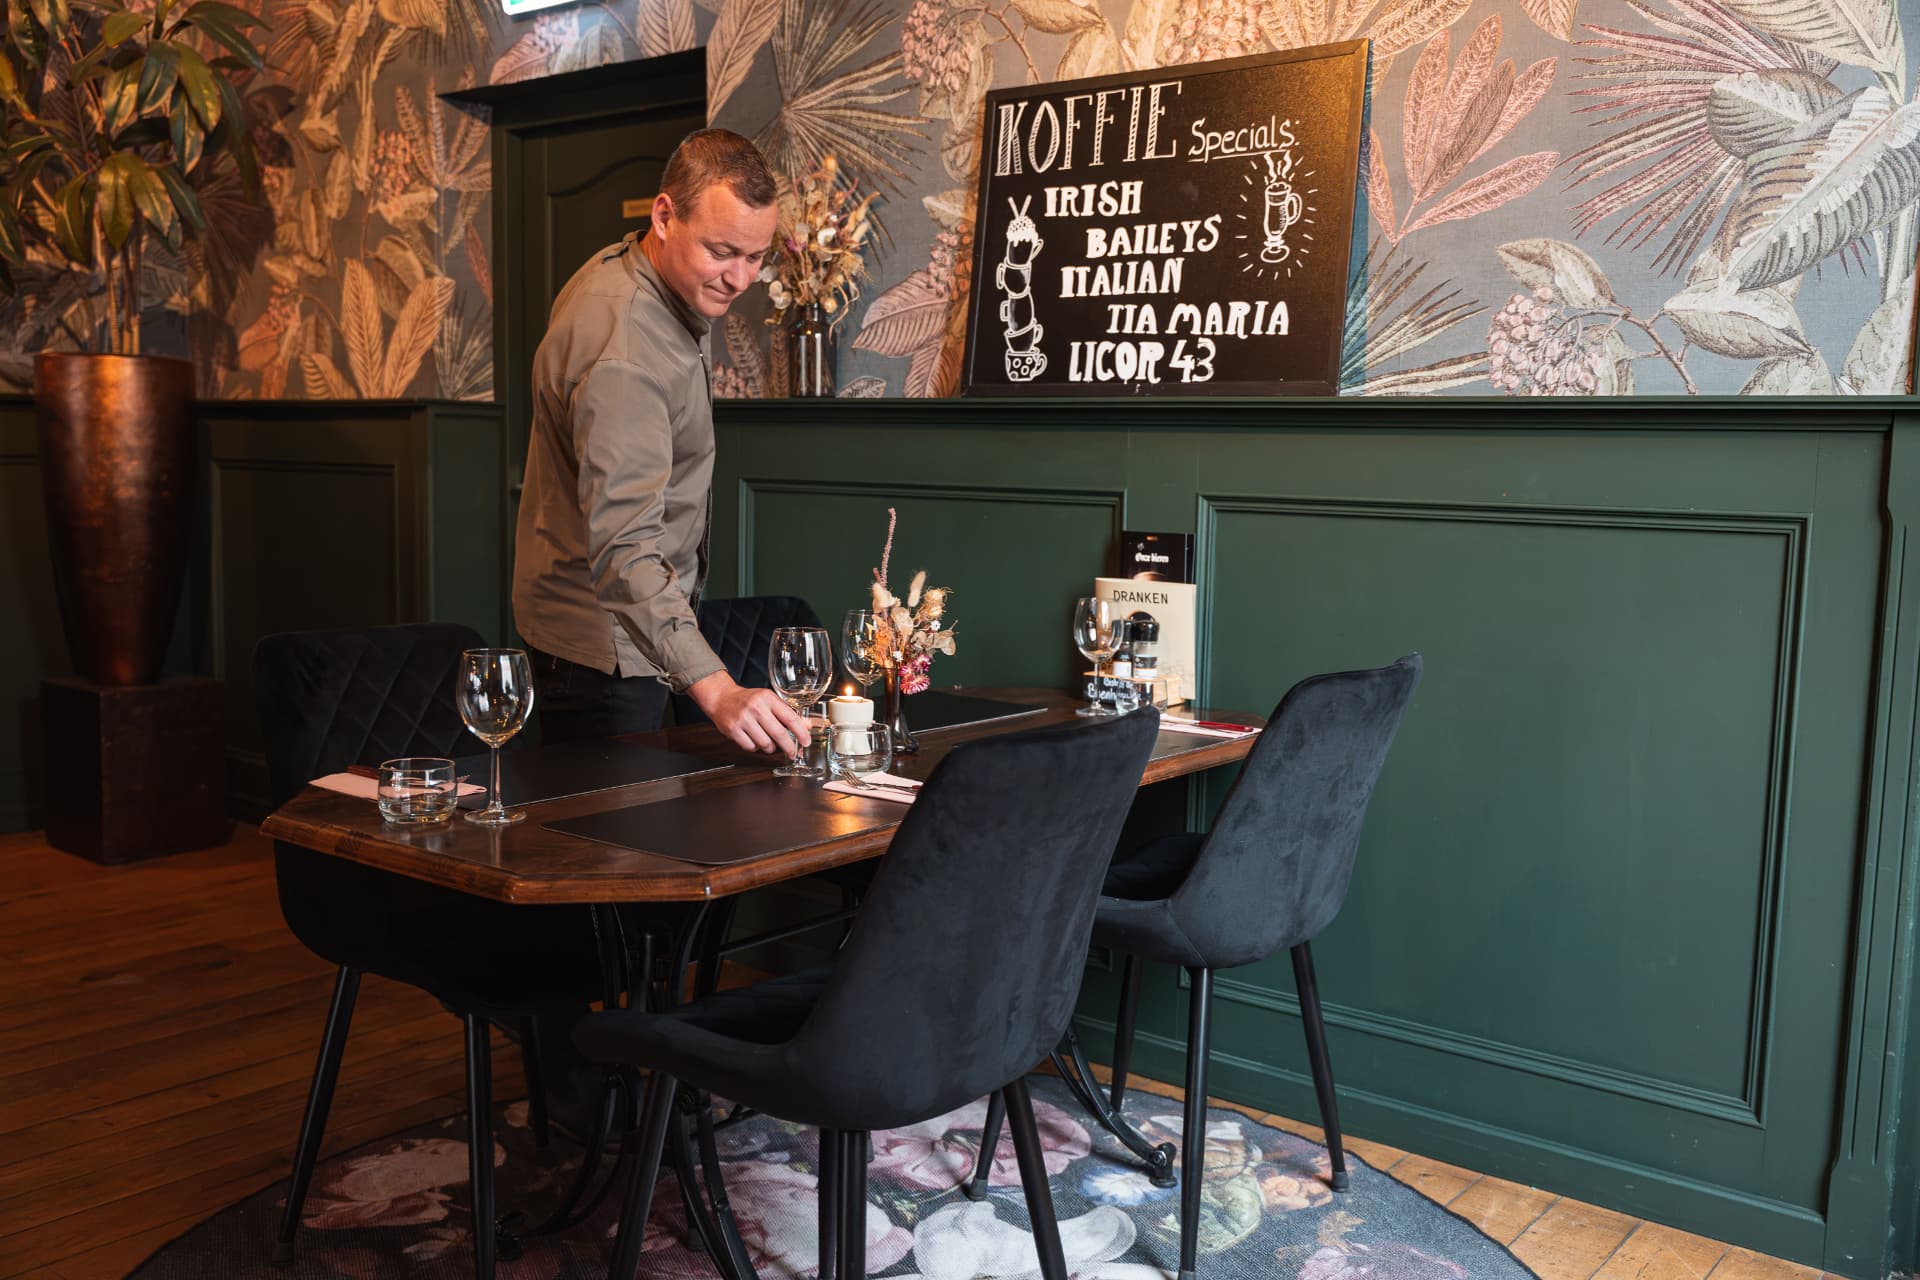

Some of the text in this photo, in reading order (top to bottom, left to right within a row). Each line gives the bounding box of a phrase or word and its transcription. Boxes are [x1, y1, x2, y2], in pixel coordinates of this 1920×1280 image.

[995, 81, 1299, 176] KOFFIE Specials:
[1044, 181, 1143, 217] IRISH
[1086, 215, 1222, 258] BAILEYS
[1059, 258, 1185, 298] ITALIAN
[1107, 301, 1289, 339] TIA MARIA
[1069, 338, 1216, 384] LICOR 43
[1113, 590, 1168, 604] DRANKEN
